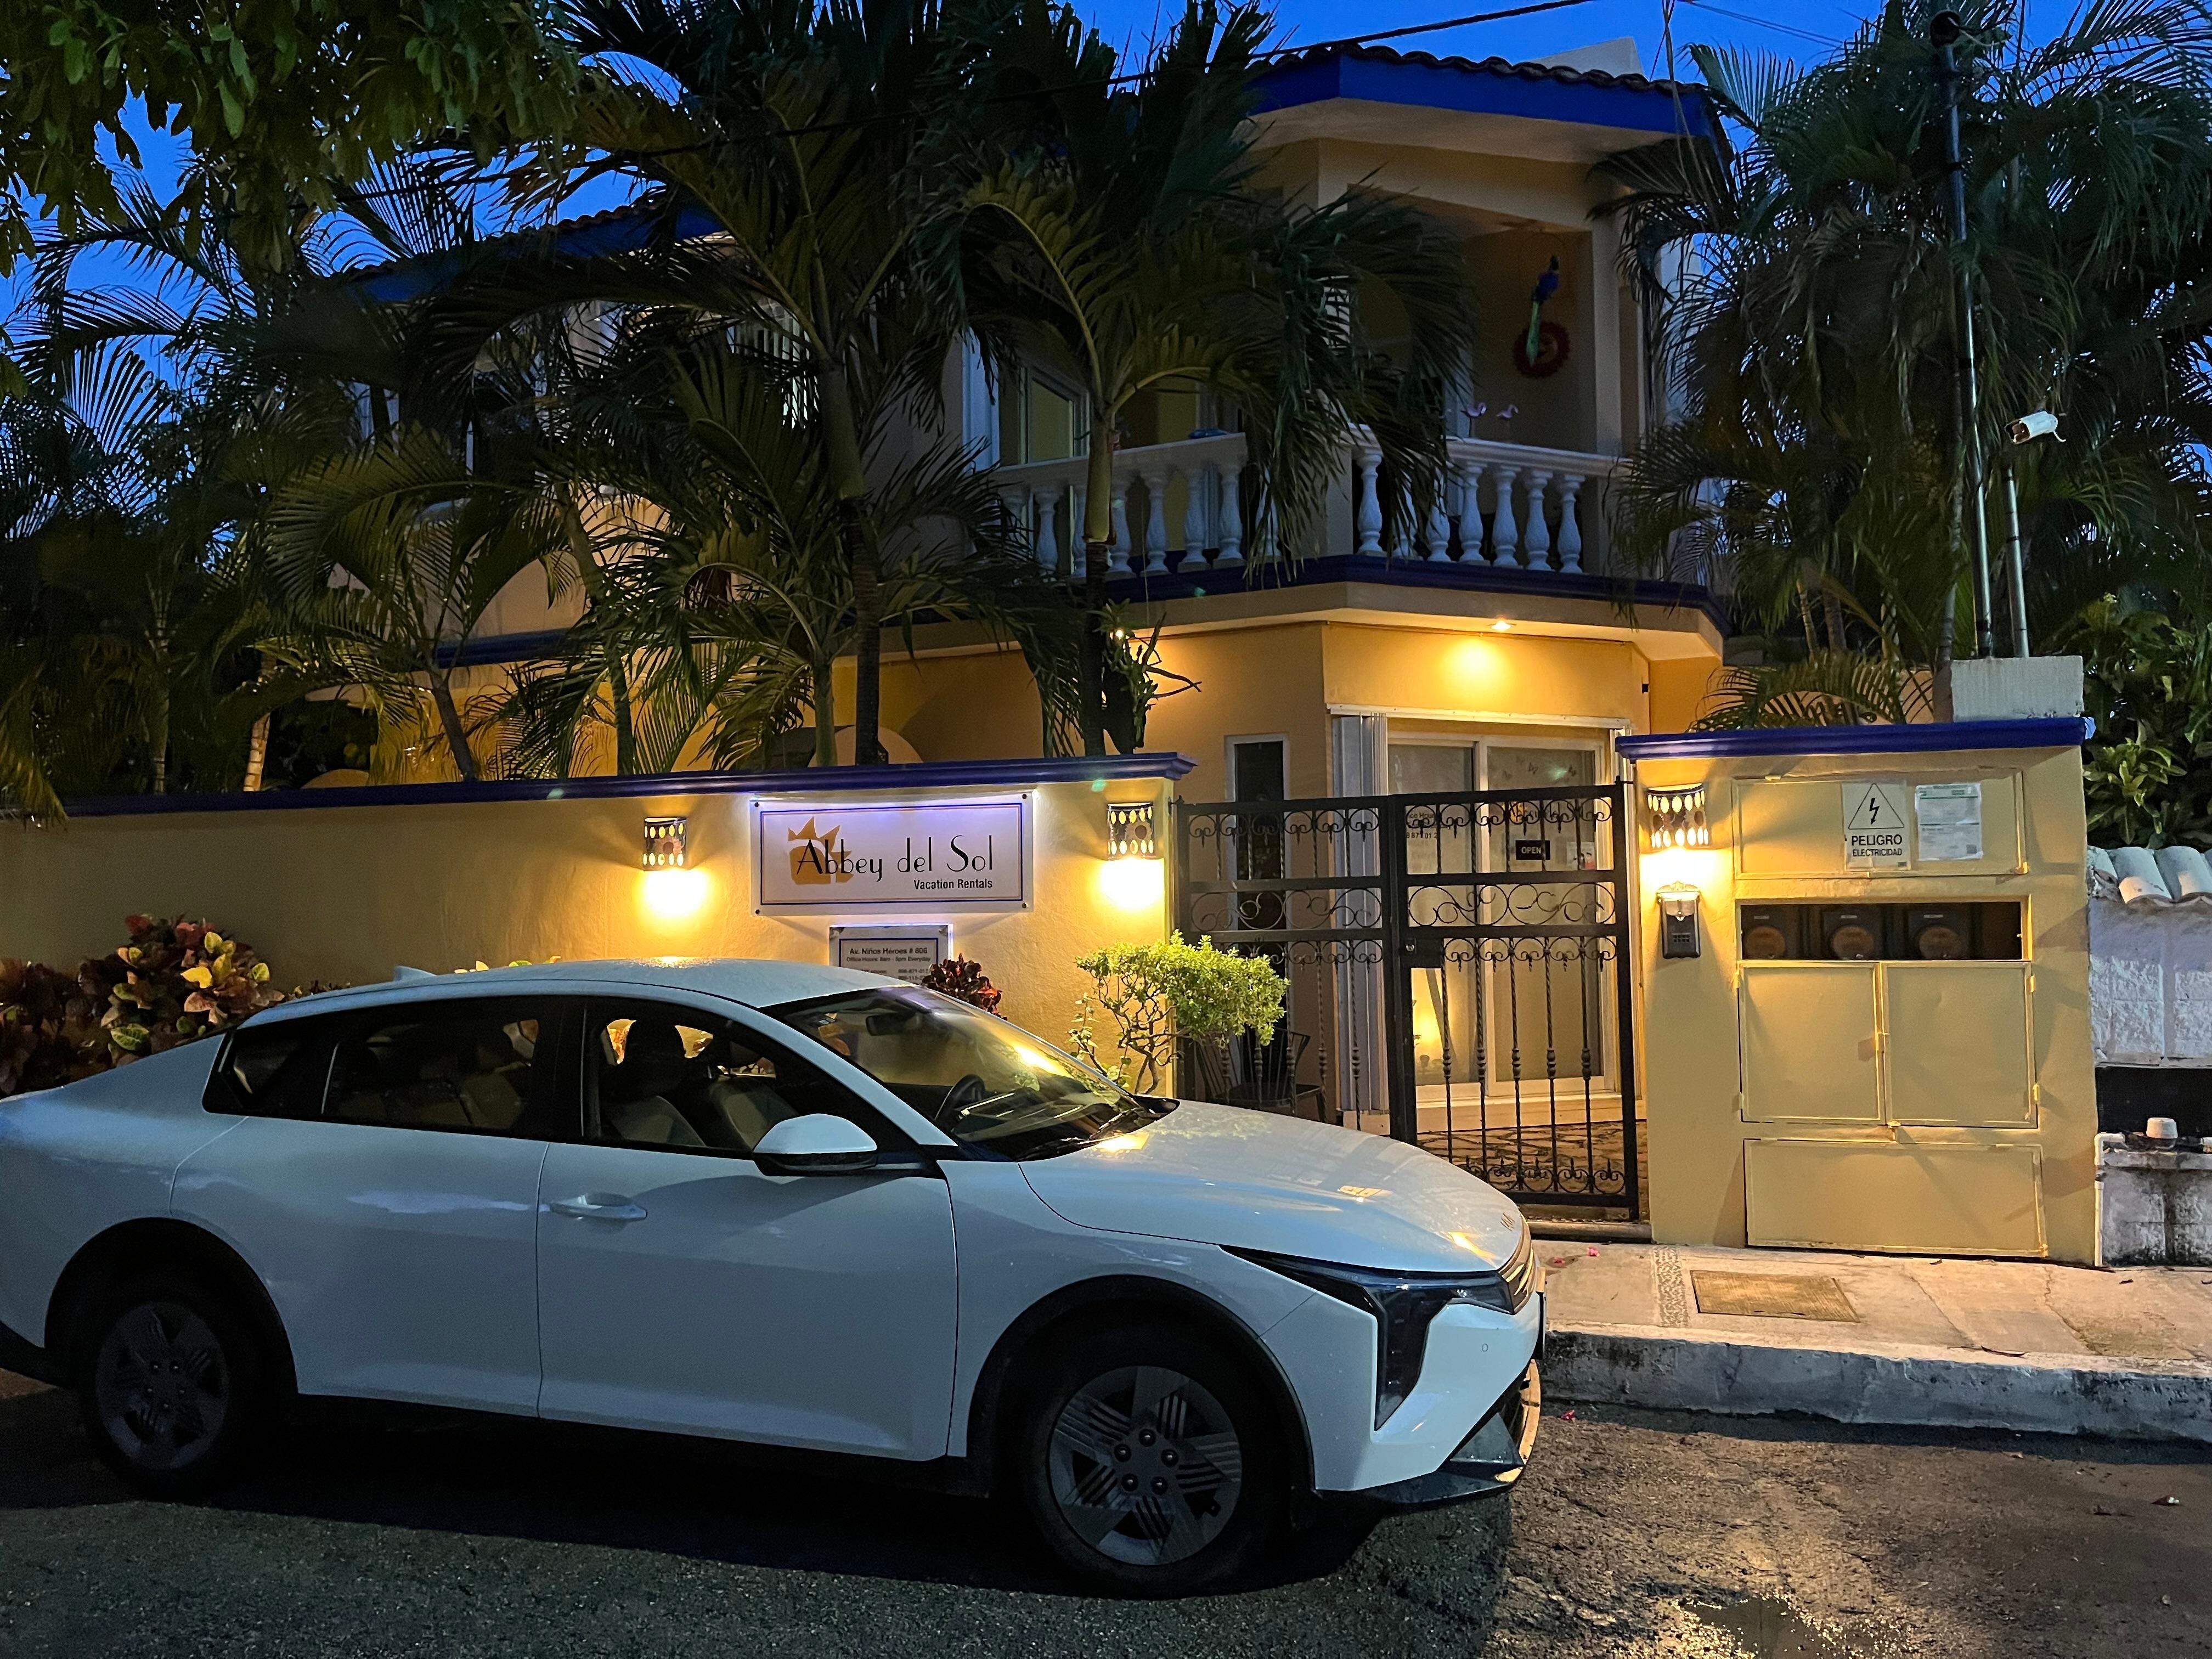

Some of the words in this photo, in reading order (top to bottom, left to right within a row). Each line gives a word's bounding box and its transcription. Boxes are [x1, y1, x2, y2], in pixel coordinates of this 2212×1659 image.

[1851, 834, 1903, 846] PELIGRO
[797, 838, 883, 882] Abbey
[897, 836, 932, 873] del
[946, 834, 992, 872] Sol
[1852, 848, 1903, 857] ELECTRICIDAD
[913, 879, 955, 890] Vacation
[957, 878, 992, 889] Rentals
